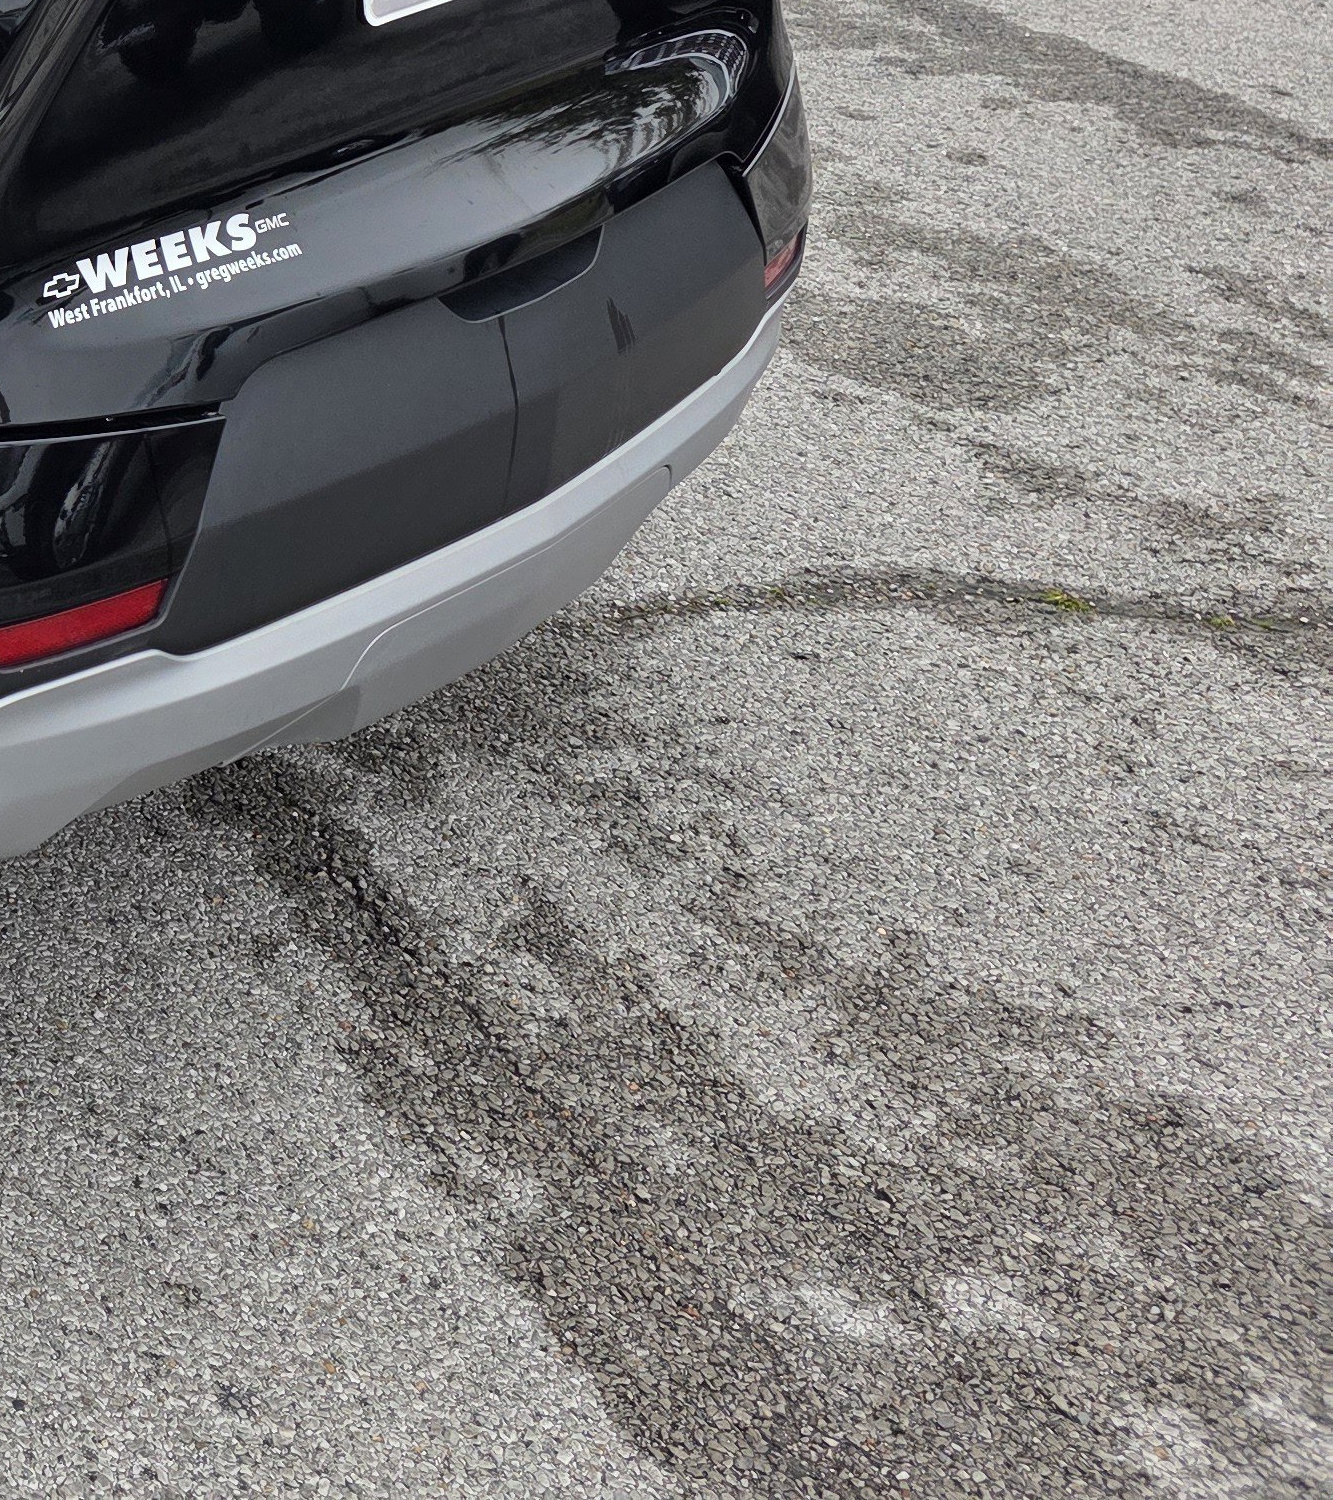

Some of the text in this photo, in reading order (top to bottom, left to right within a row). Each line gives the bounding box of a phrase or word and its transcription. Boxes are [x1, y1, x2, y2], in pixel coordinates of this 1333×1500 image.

[47, 241, 303, 329] West Frankfort, IL gregweeks.com
[75, 212, 290, 295] WEEKS GMC
